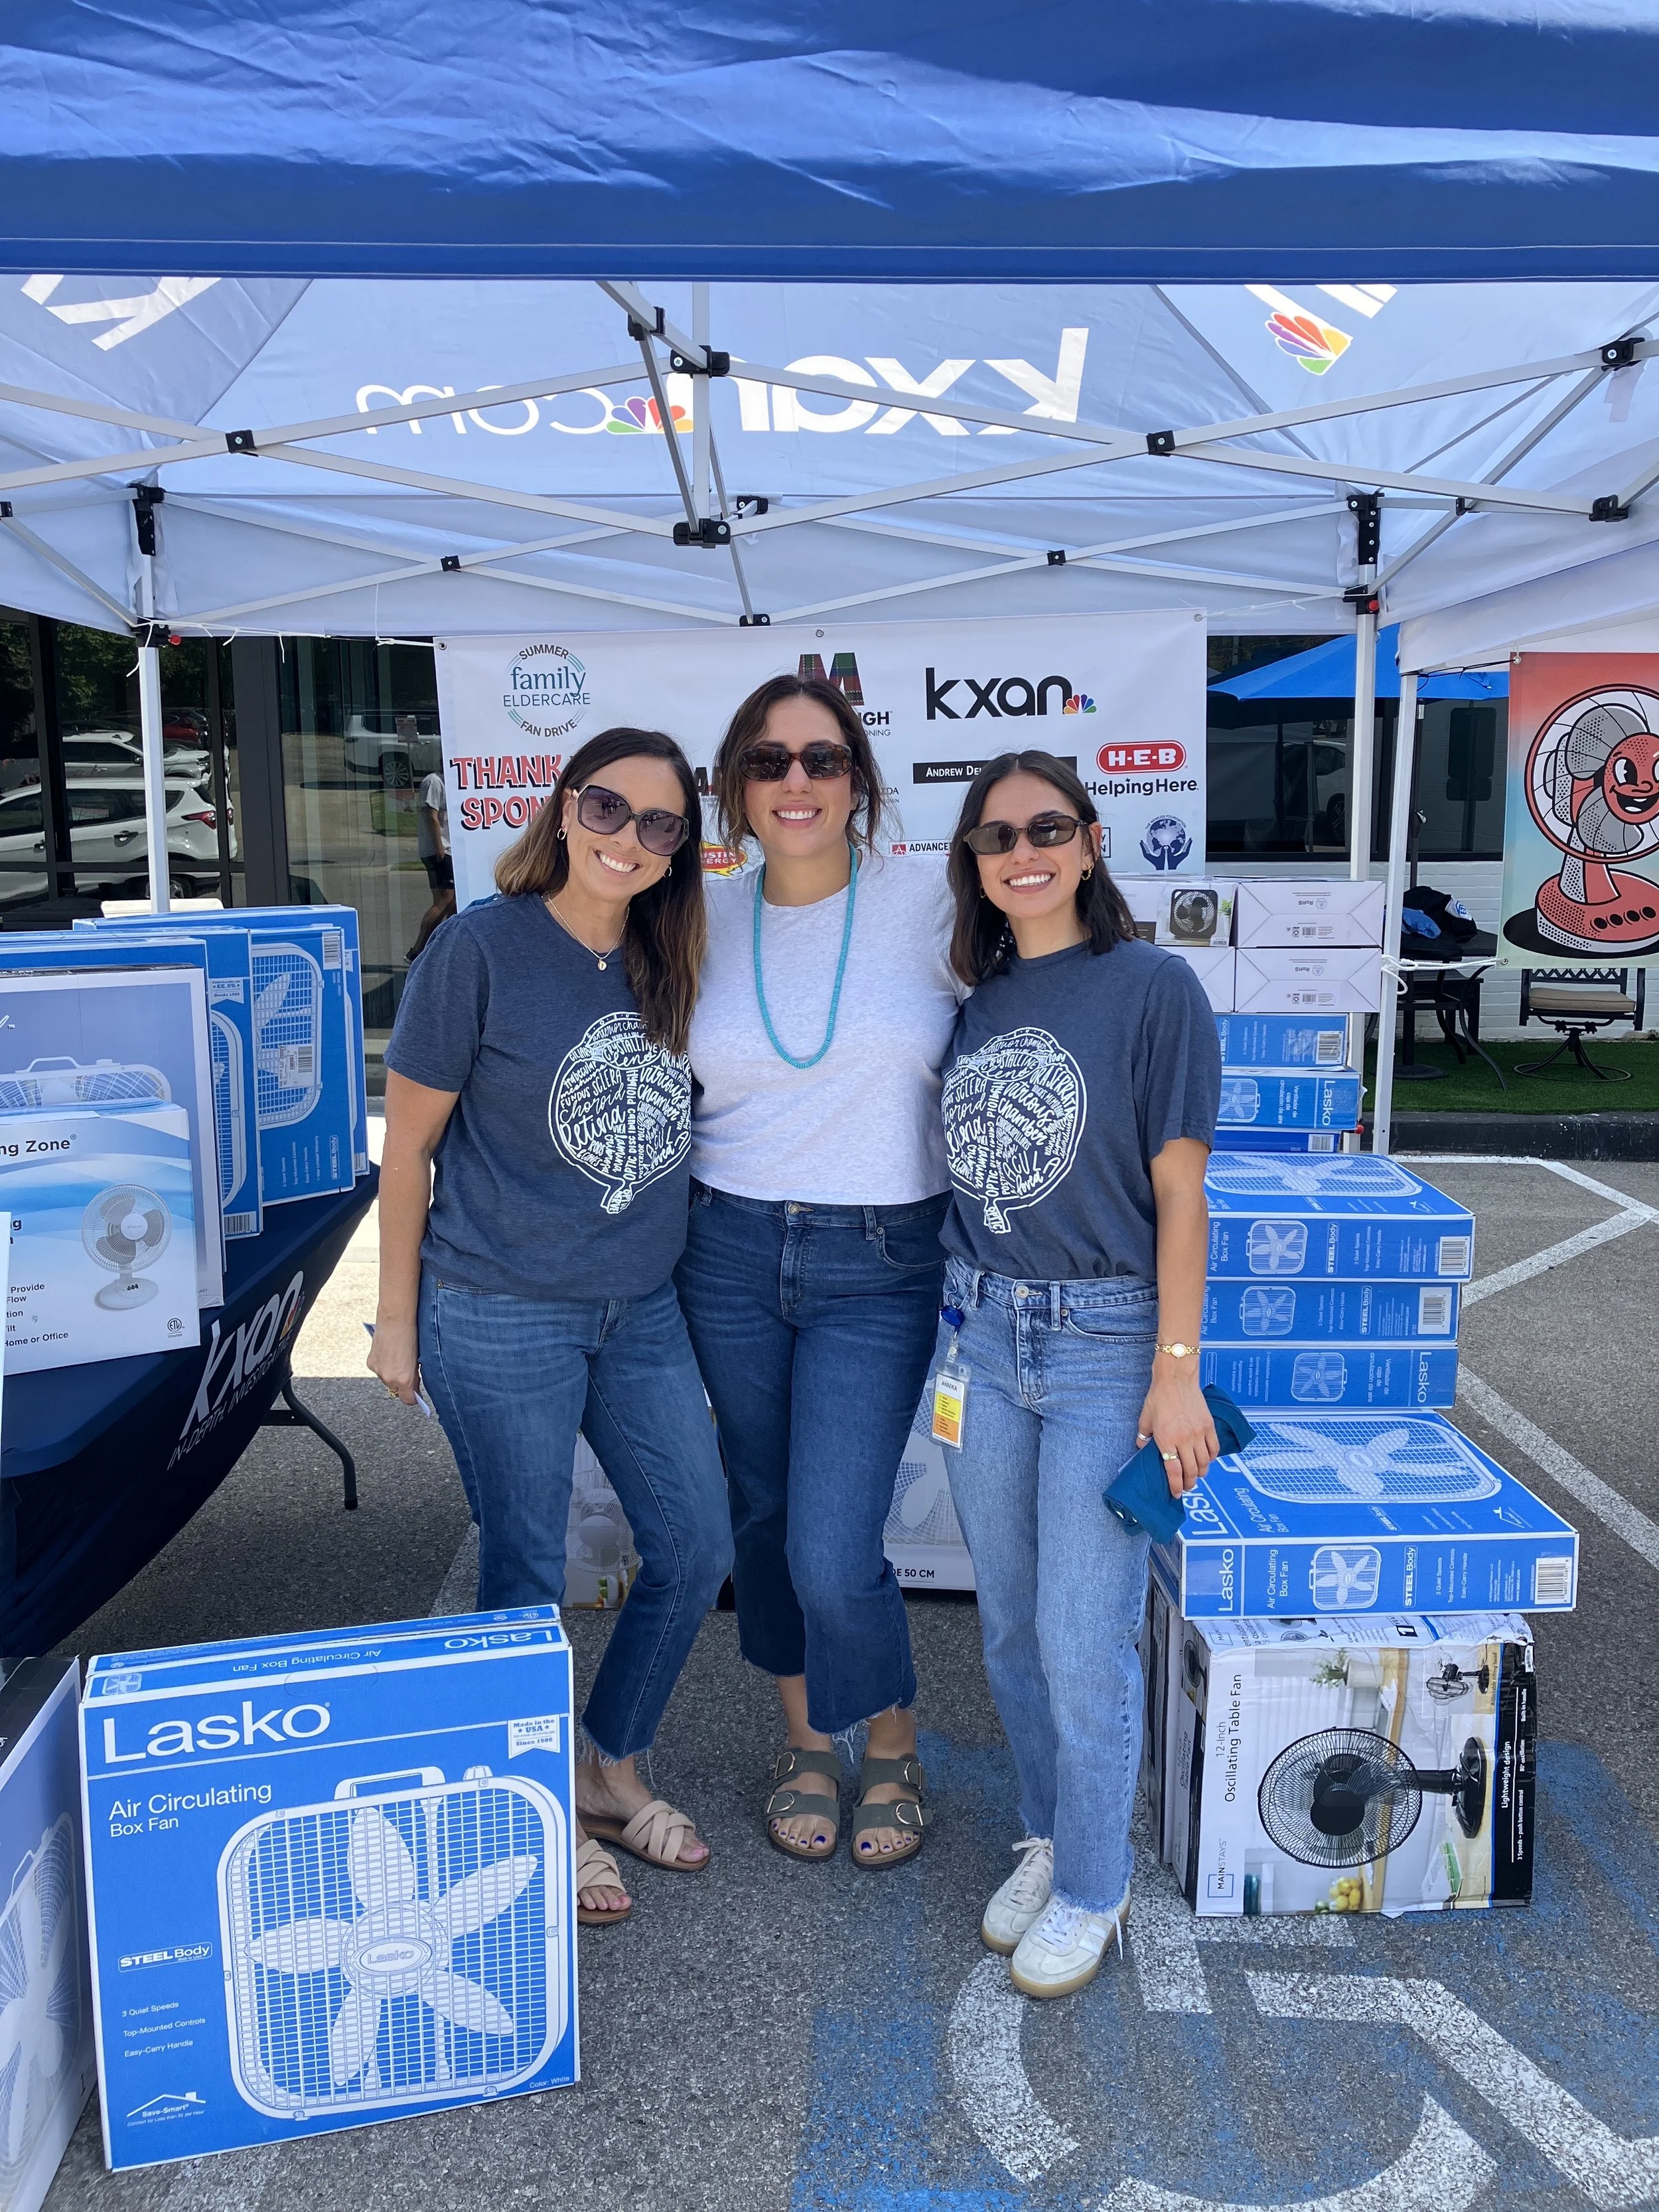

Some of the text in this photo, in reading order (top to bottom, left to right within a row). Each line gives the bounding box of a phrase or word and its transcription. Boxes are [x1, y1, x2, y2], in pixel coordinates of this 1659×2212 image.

[519, 644, 569, 660] SUMMER
[510, 666, 586, 697] family
[925, 667, 1073, 720] kxan
[503, 692, 591, 707] ELDERCARE
[520, 719, 577, 737] FAN DRIVE
[1108, 747, 1177, 767] H-E-B
[449, 755, 561, 790] THANK
[926, 767, 963, 777] ANDREW
[461, 796, 551, 831] SPON
[592, 1069, 622, 1096] SCLERA
[956, 1077, 987, 1102] SCLERA
[561, 1086, 590, 1109] FUNDUS
[1322, 1080, 1336, 1126] Lasko
[623, 1155, 637, 1181] OPTIC
[985, 1169, 999, 1197] OPTIC
[1210, 1221, 1220, 1260] Circulating
[1329, 1223, 1338, 1244] Body
[11, 1284, 44, 1293] Provide
[42, 1332, 68, 1341] Office
[1417, 1352, 1432, 1403] Lasko
[1234, 1487, 1267, 1522] Circulating
[904, 1568, 917, 1578] 50
[919, 1568, 935, 1578] CM
[1218, 1548, 1234, 1611] Lasko
[1267, 1549, 1279, 1609] Air Circulating
[1405, 1547, 1415, 1606] STEEL Body
[445, 1630, 552, 1649] Lasko
[233, 1649, 382, 1672] Air Circulating Box Fan
[104, 1700, 330, 1764] Lasko
[1216, 1722, 1226, 1757] 12-Inch
[1224, 1674, 1241, 1802] Oscillating Table Fan
[1501, 1766, 1511, 1808] Lightweight
[109, 1783, 272, 1820] Air Circulating
[110, 1815, 179, 1838] Box Fan
[1217, 1841, 1226, 1889] MAINSTAYS
[120, 1945, 210, 1968] STEEL Body
[368, 1951, 413, 1964] Lasko
[129, 2007, 149, 2016] Quiet
[151, 2002, 179, 2012] Speeds
[123, 2017, 206, 2037] Top-Mounted Controls
[124, 2039, 193, 2057] Easy-Carry Handle
